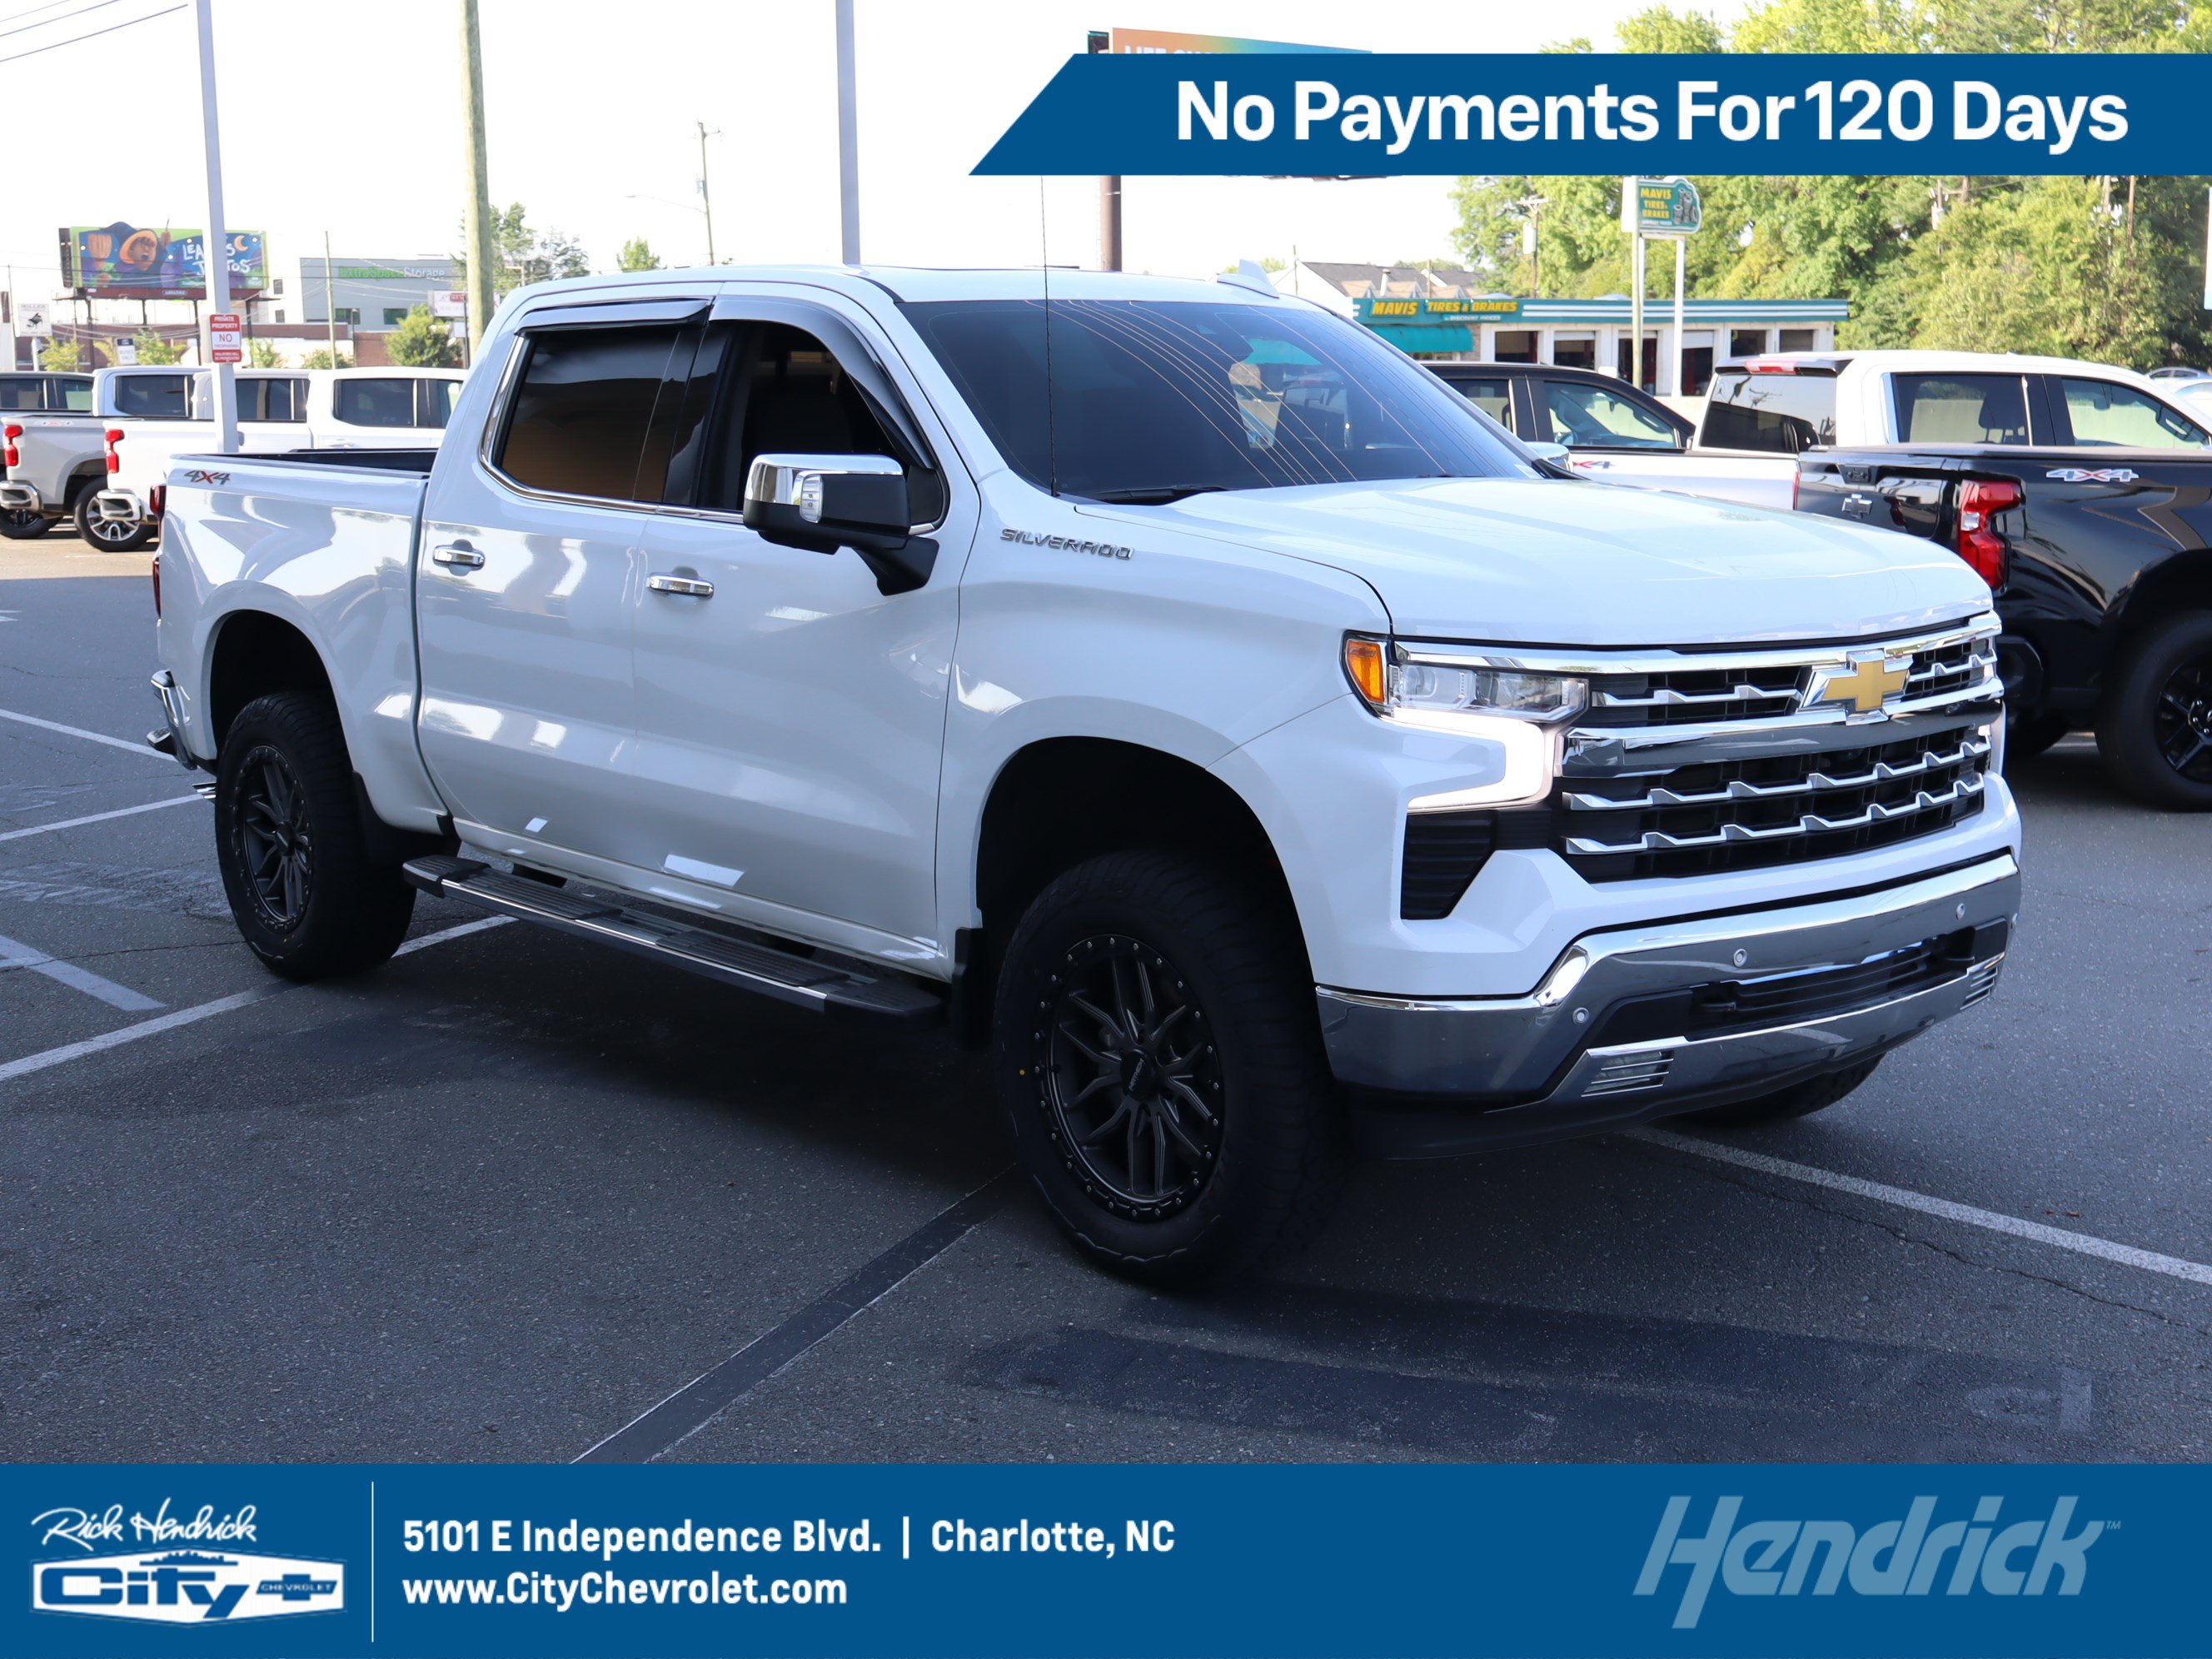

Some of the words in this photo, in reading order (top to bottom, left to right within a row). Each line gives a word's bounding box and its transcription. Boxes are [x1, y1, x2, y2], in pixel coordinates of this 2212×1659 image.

[1640, 187, 1671, 199] MAVIS
[1644, 200, 1665, 209] TIRES
[1642, 209, 1670, 218] BRAKES
[1372, 301, 1417, 315] MAVIS
[1427, 301, 1462, 311] TIRES
[1472, 301, 1518, 312] BRAKES
[219, 333, 232, 342] NO
[183, 470, 231, 486] 4X4
[1000, 527, 1135, 560] SILVERADO
